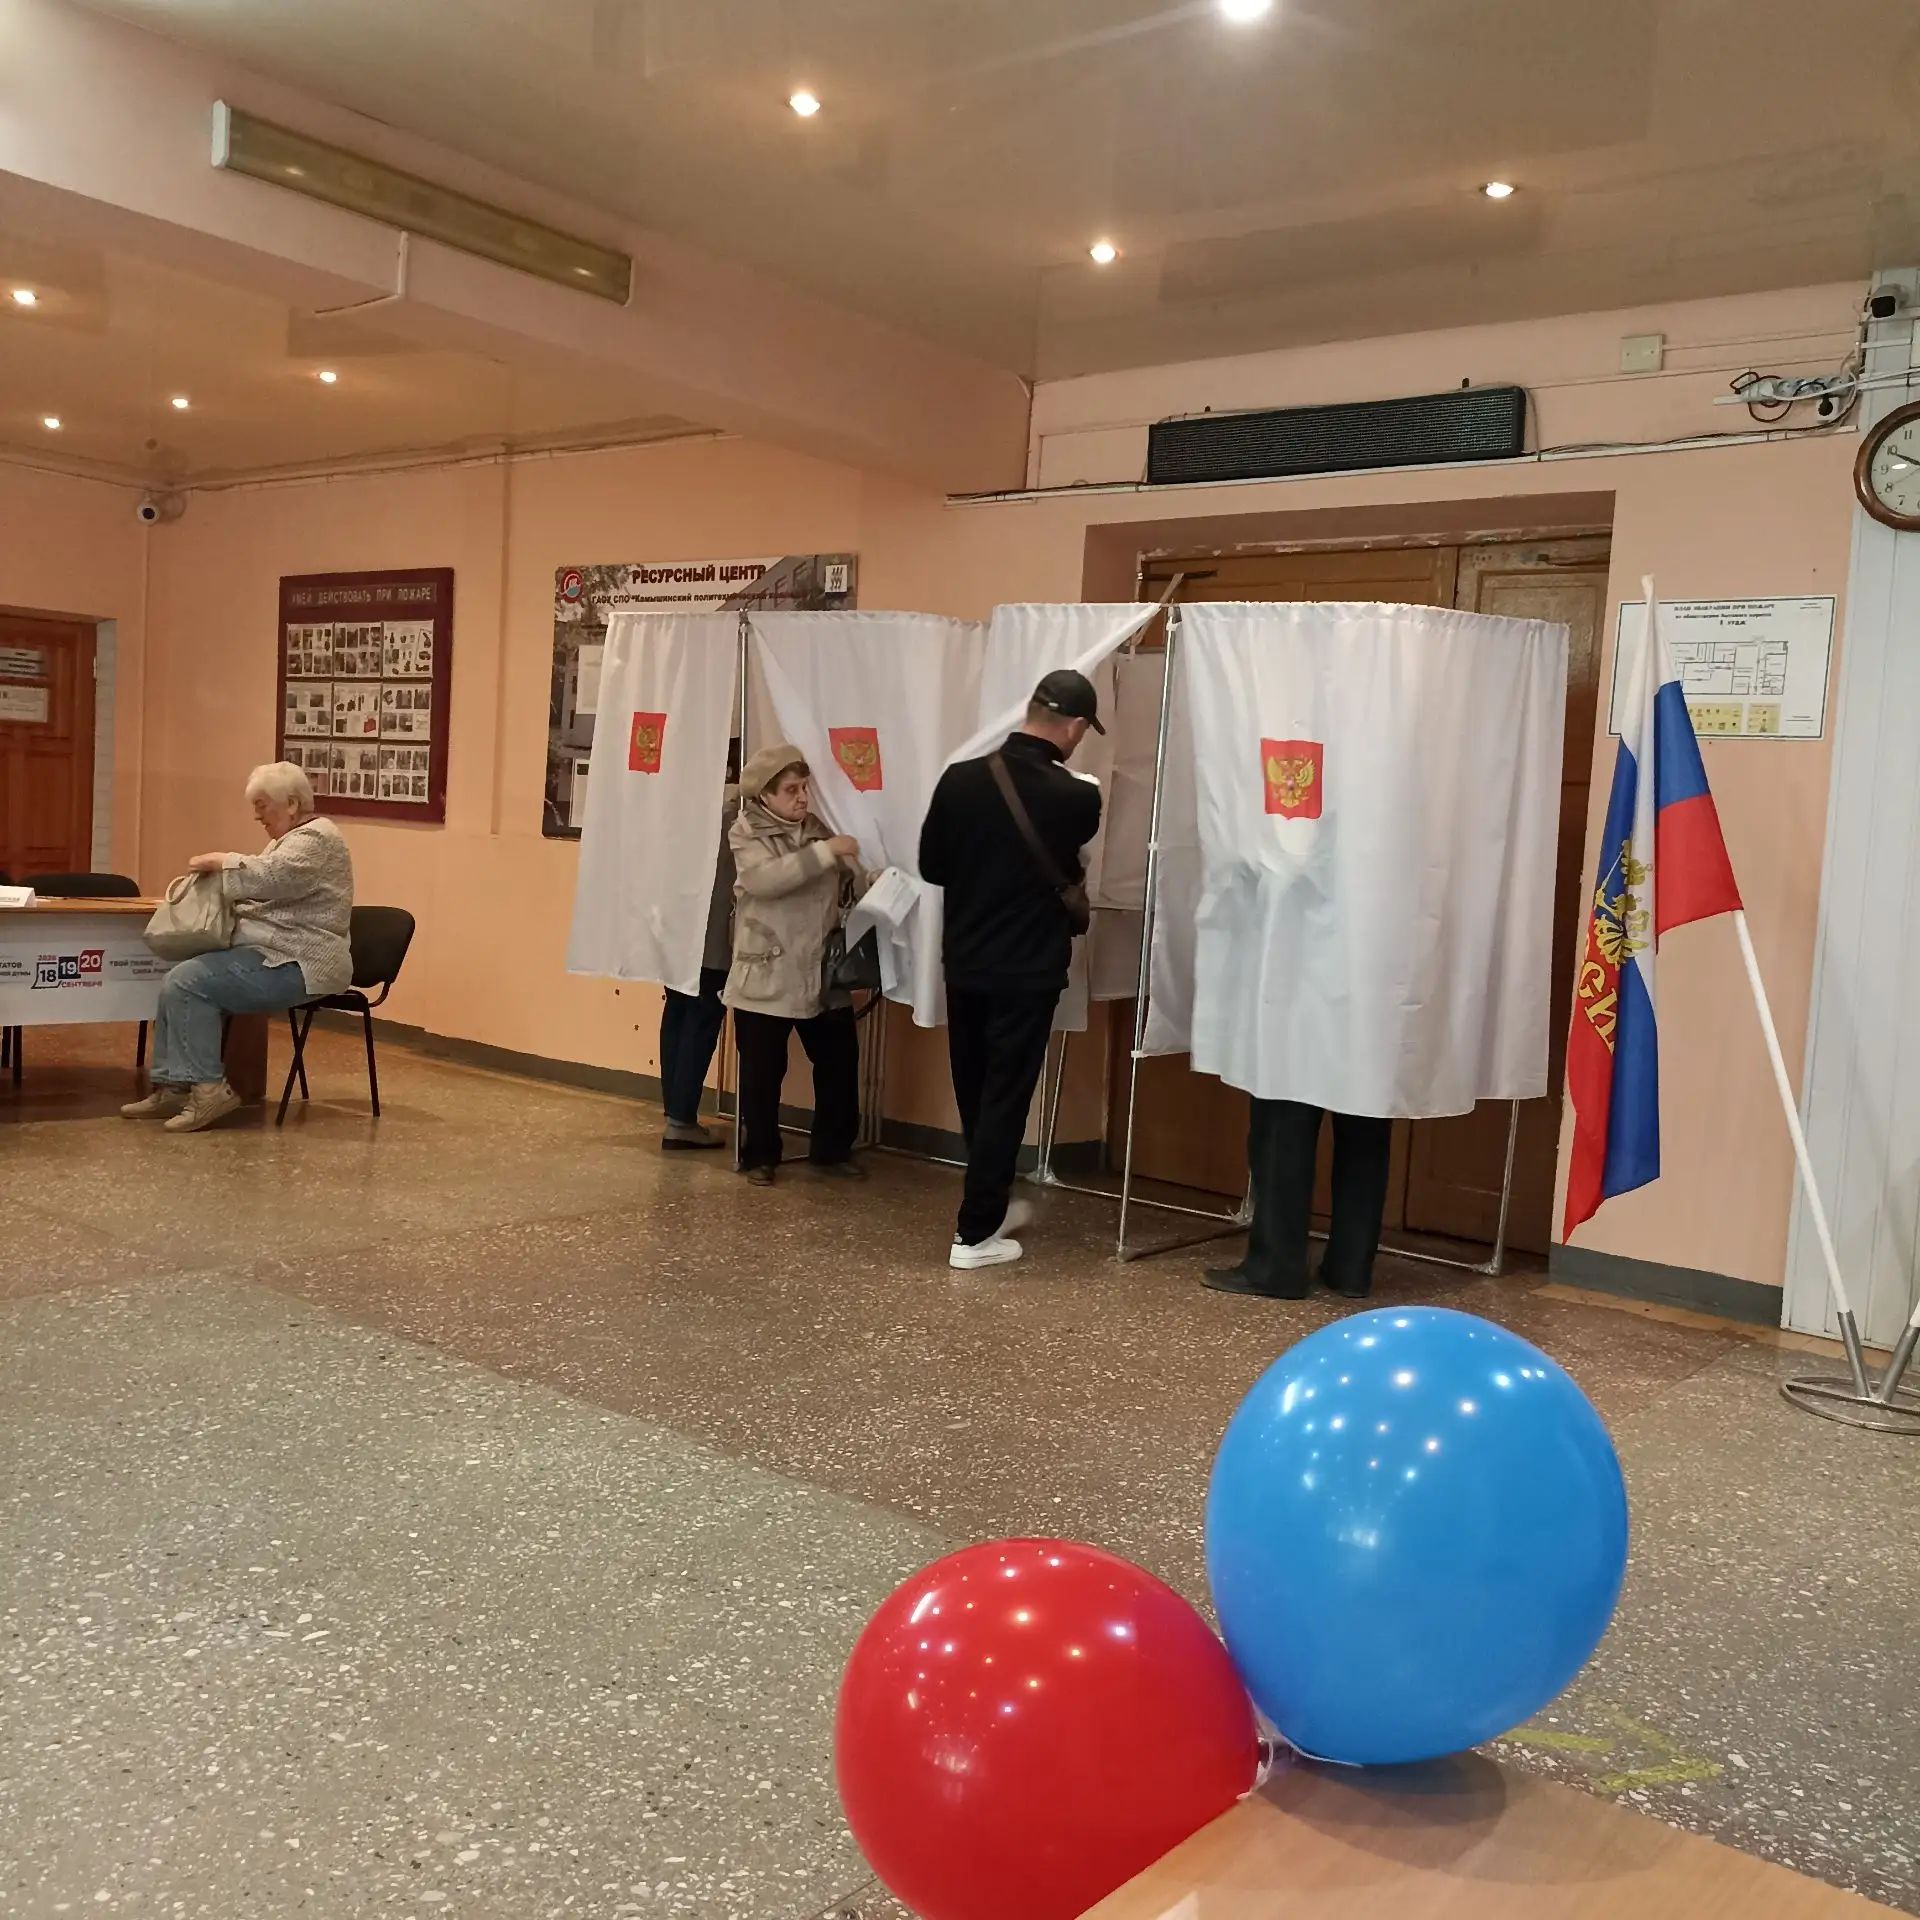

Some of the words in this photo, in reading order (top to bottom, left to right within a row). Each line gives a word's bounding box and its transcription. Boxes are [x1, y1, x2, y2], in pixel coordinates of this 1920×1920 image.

[1904, 429, 1912, 440] 11
[1887, 444, 1898, 456] 10
[1880, 464, 1889, 475] 9
[1885, 482, 1893, 493] 8
[1898, 494, 1905, 506] 7
[631, 563, 716, 584] РЕСУРСНЫЙ
[719, 564, 767, 583] ЦЕНТР
[318, 588, 371, 605] ДЕЙСТВОВАТЬ
[376, 588, 392, 601] ПРИ
[398, 586, 431, 601] ПОЖАРЕ
[613, 594, 630, 604] СПО
[40, 969, 57, 982] 18
[60, 961, 77, 975] 19
[81, 954, 101, 968] 20
